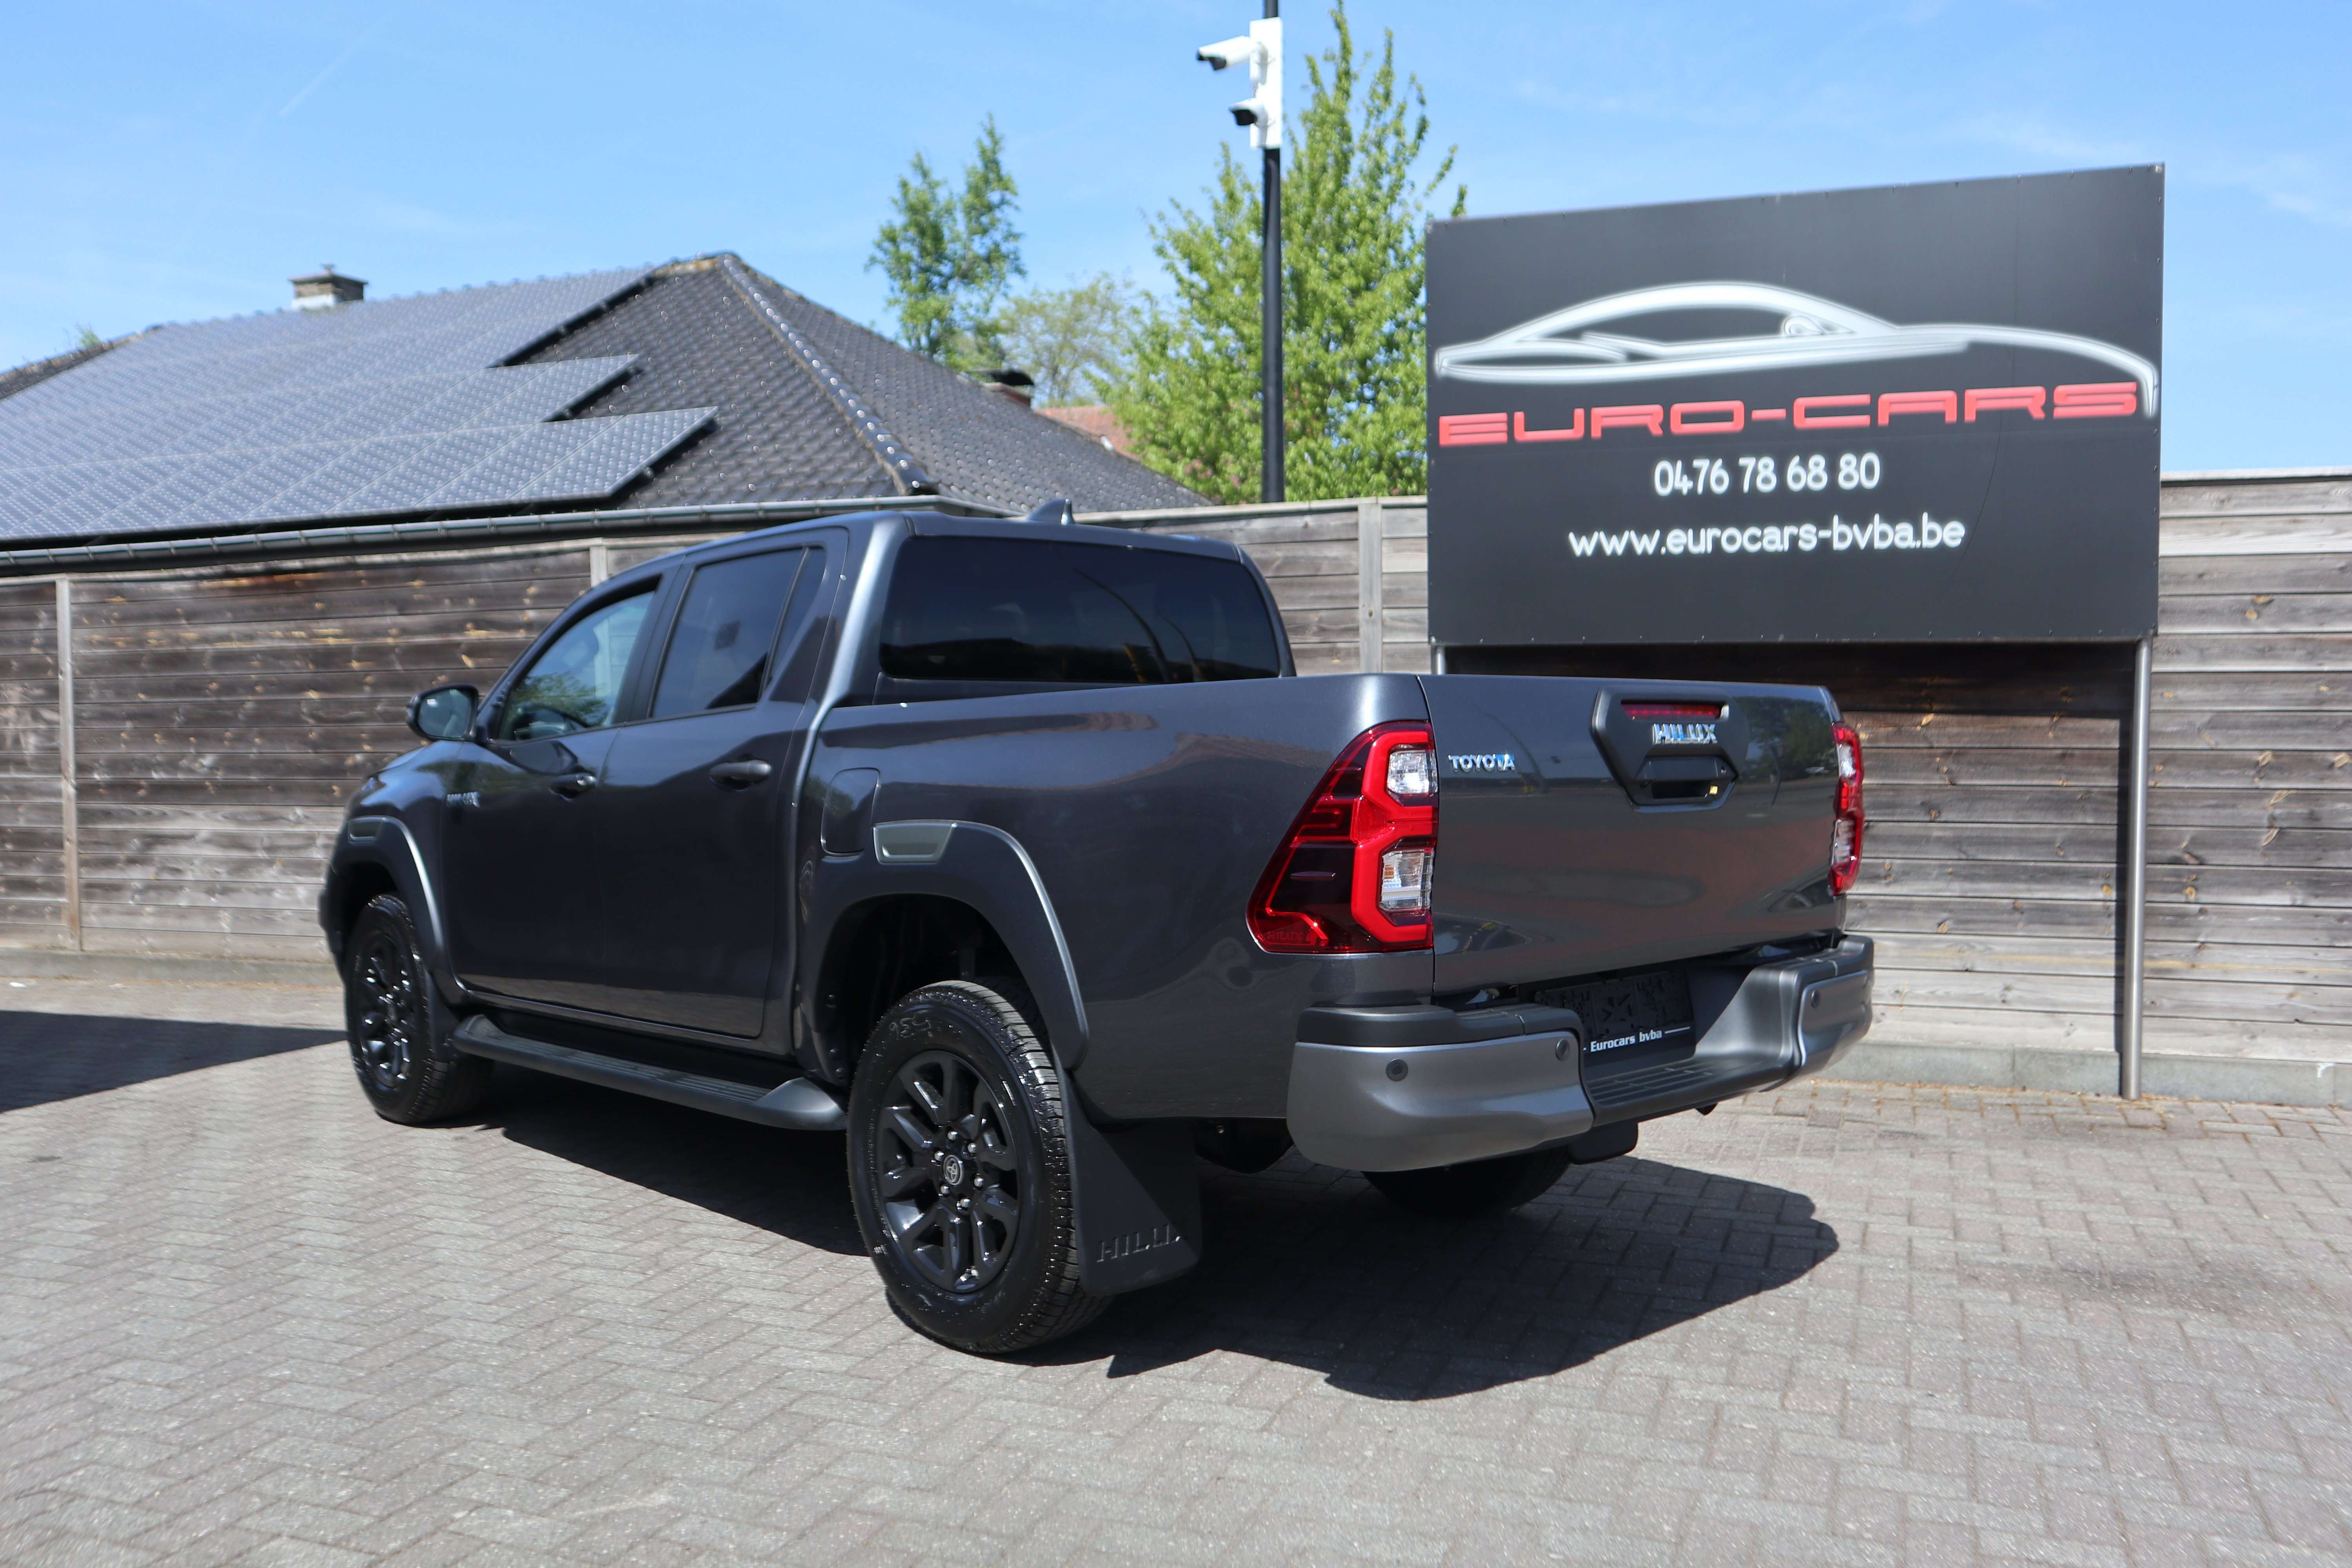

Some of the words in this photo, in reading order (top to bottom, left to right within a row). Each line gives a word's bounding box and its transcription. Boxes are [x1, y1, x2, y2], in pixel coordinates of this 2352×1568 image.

[1439, 381, 2138, 447] EURO-CARS
[1654, 457, 1729, 496] 0476
[1739, 456, 1777, 494] 78
[1786, 455, 1828, 492] 68
[1838, 452, 1881, 490] 80
[1568, 511, 1965, 557] www.eurocars-bvba.be
[1652, 723, 1718, 745] HILUX
[1448, 753, 1515, 772] TOYOTA
[1590, 1034, 1636, 1052] Eurocars
[1639, 1029, 1662, 1043] bvba
[1096, 1223, 1182, 1263] HILU
